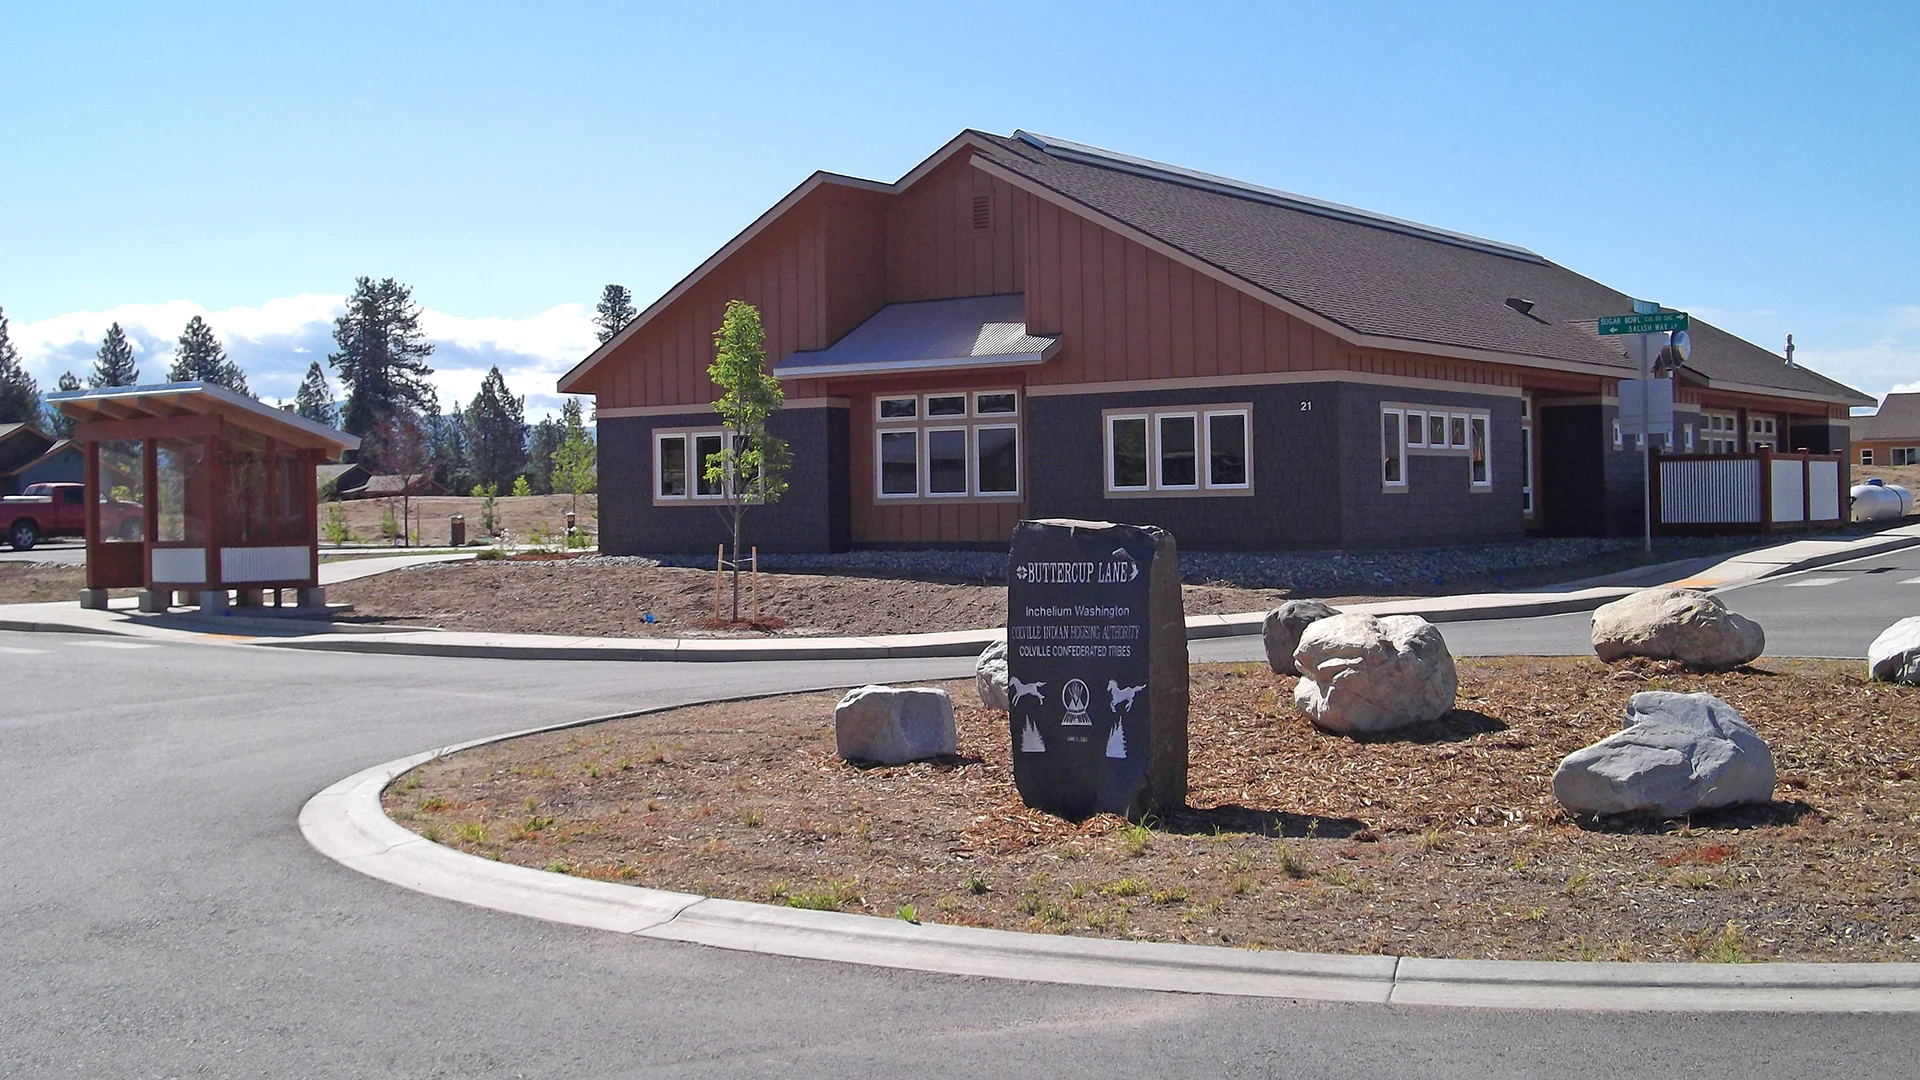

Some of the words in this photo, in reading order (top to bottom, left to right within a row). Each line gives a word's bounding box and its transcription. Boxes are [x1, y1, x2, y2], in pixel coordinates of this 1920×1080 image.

[1601, 317, 1621, 326] SUGAR
[1625, 316, 1641, 324] BOWL
[1628, 324, 1652, 333] SALISH
[1655, 323, 1668, 331] WAY
[1300, 401, 1311, 411] 21
[1027, 562, 1094, 583] BUTTERCUP
[1098, 561, 1128, 583] LANE
[1025, 606, 1072, 617] Inchelium
[1075, 605, 1130, 618] Washington
[1012, 625, 1042, 640] COLVILLE
[1043, 625, 1069, 640] INDIAN
[1070, 625, 1100, 640] HOUSING
[1102, 625, 1140, 640] AUTHORITY
[1020, 645, 1051, 657] COLVILLE
[1052, 645, 1106, 657] CONFEDERATED
[1108, 645, 1131, 657] TRIBES
